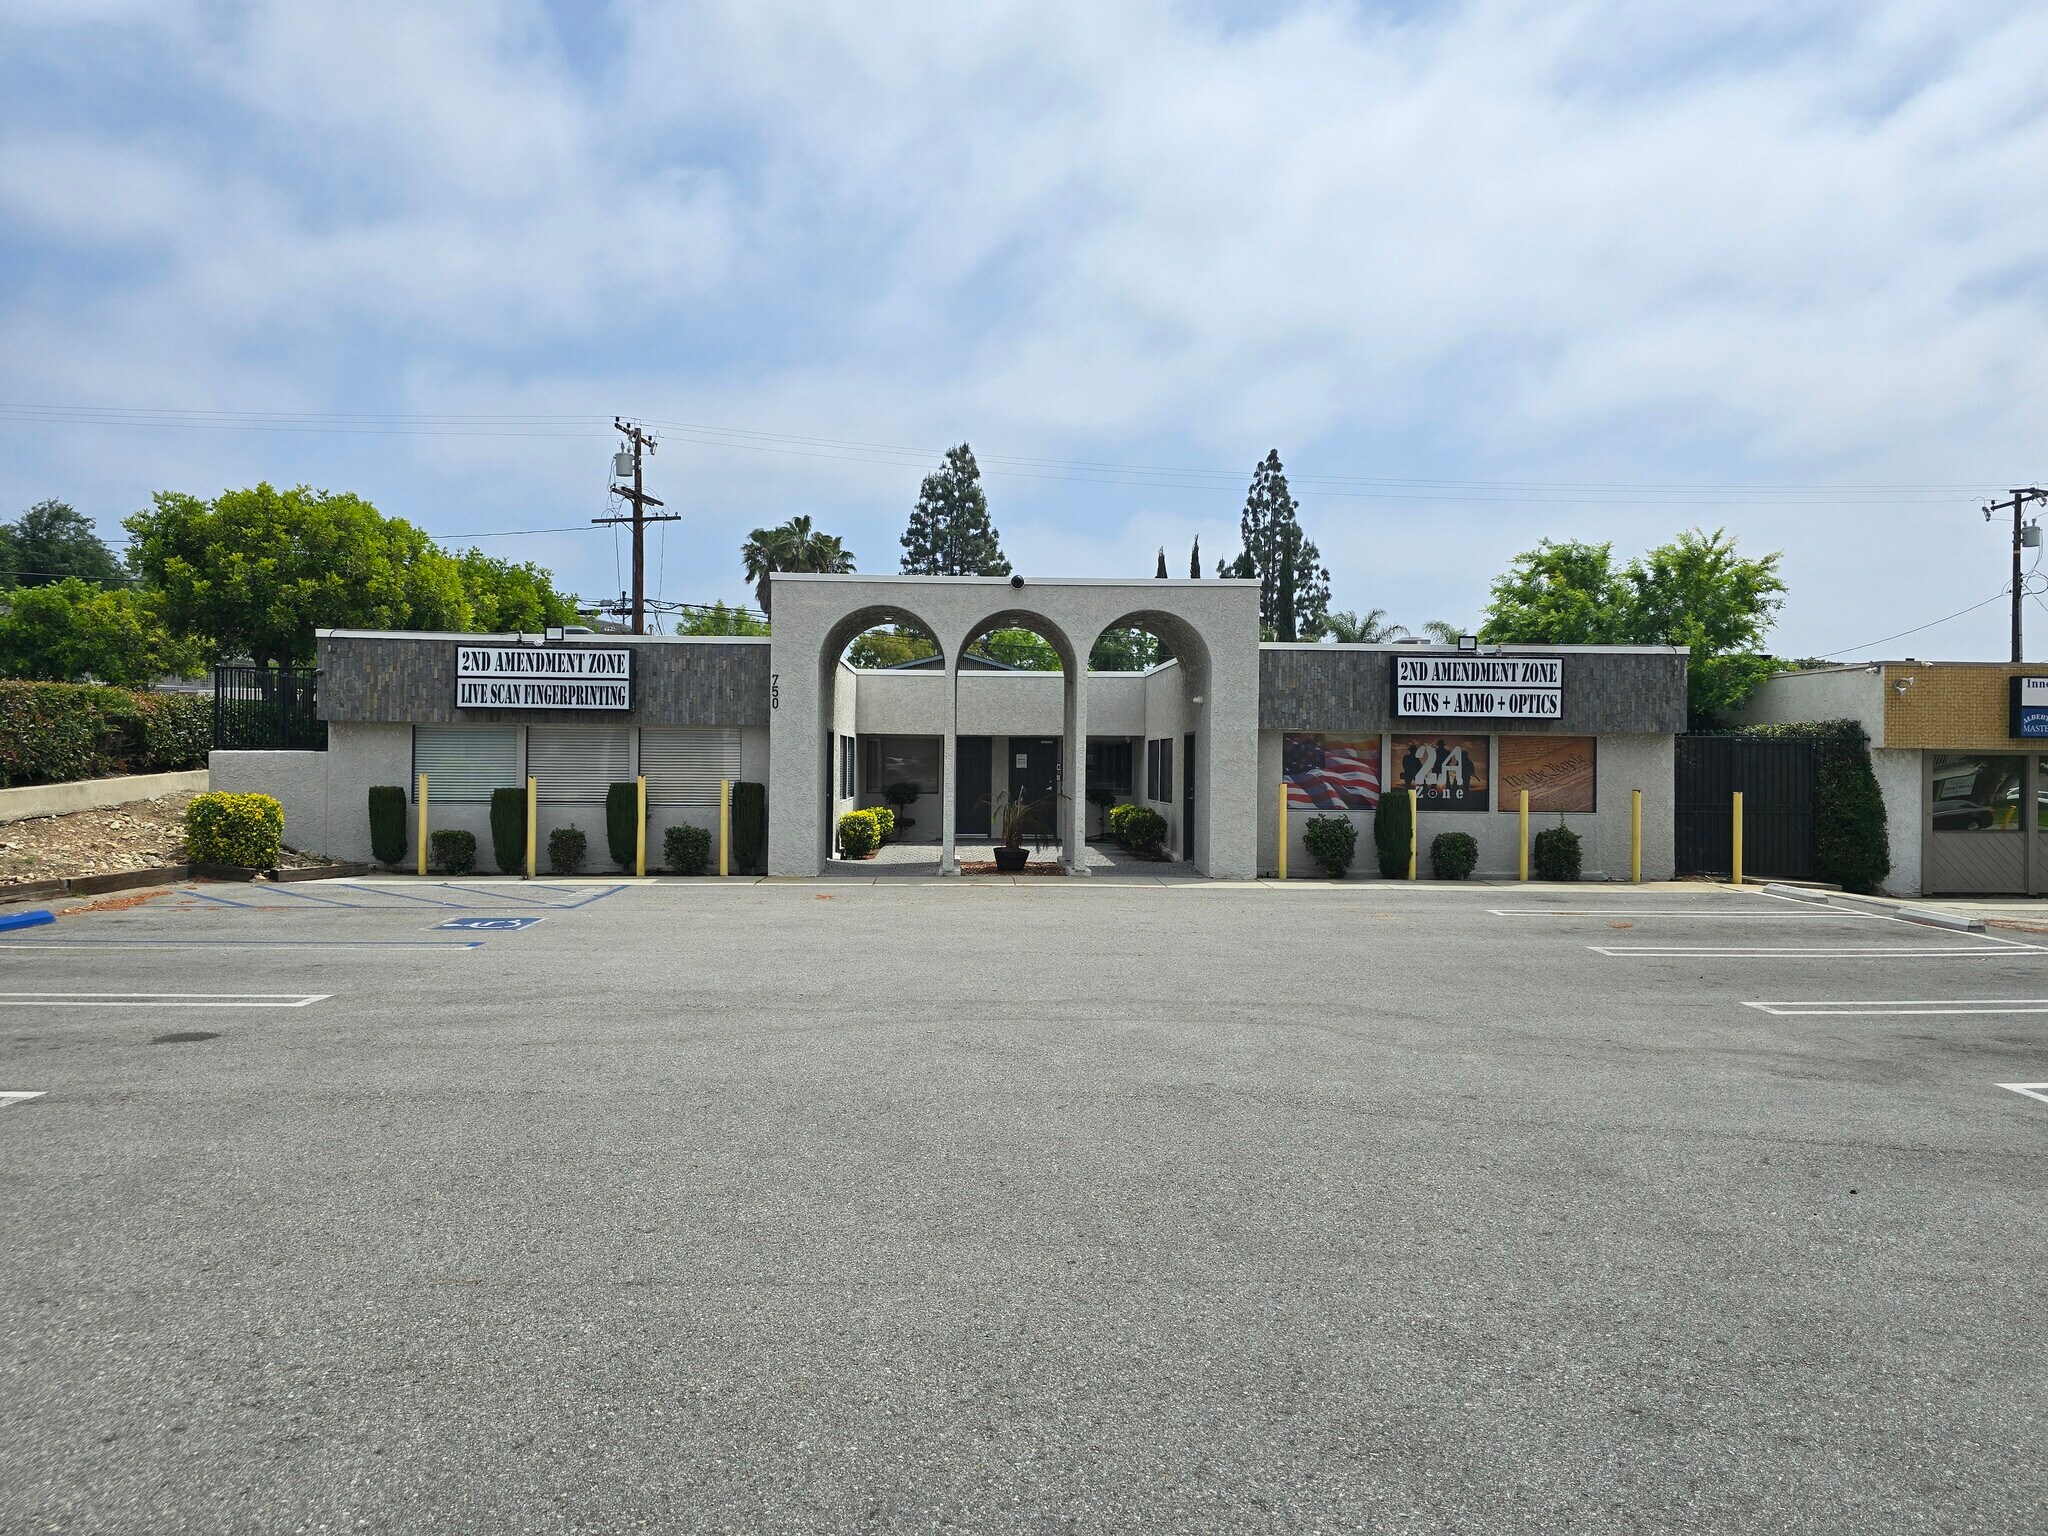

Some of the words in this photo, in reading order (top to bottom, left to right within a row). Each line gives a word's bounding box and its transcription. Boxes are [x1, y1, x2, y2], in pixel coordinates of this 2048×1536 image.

[462, 651, 490, 672] 2ND
[494, 652, 585, 673] AMENDMENT
[588, 653, 625, 674] ZONE
[1400, 661, 1428, 681] 2ND
[1431, 662, 1518, 682] AMENDMENT
[1521, 663, 1557, 683] ZONE
[461, 683, 488, 704] LIVE
[490, 683, 521, 704] SCAN
[524, 684, 626, 706] FINGERPRINTING
[1403, 692, 1439, 712] GUNS
[1454, 693, 1494, 713] AMMO
[1509, 693, 1557, 714] OPTICS
[1415, 744, 1463, 785] 2A
[1502, 773, 1530, 788] We
[1541, 753, 1586, 778] People
